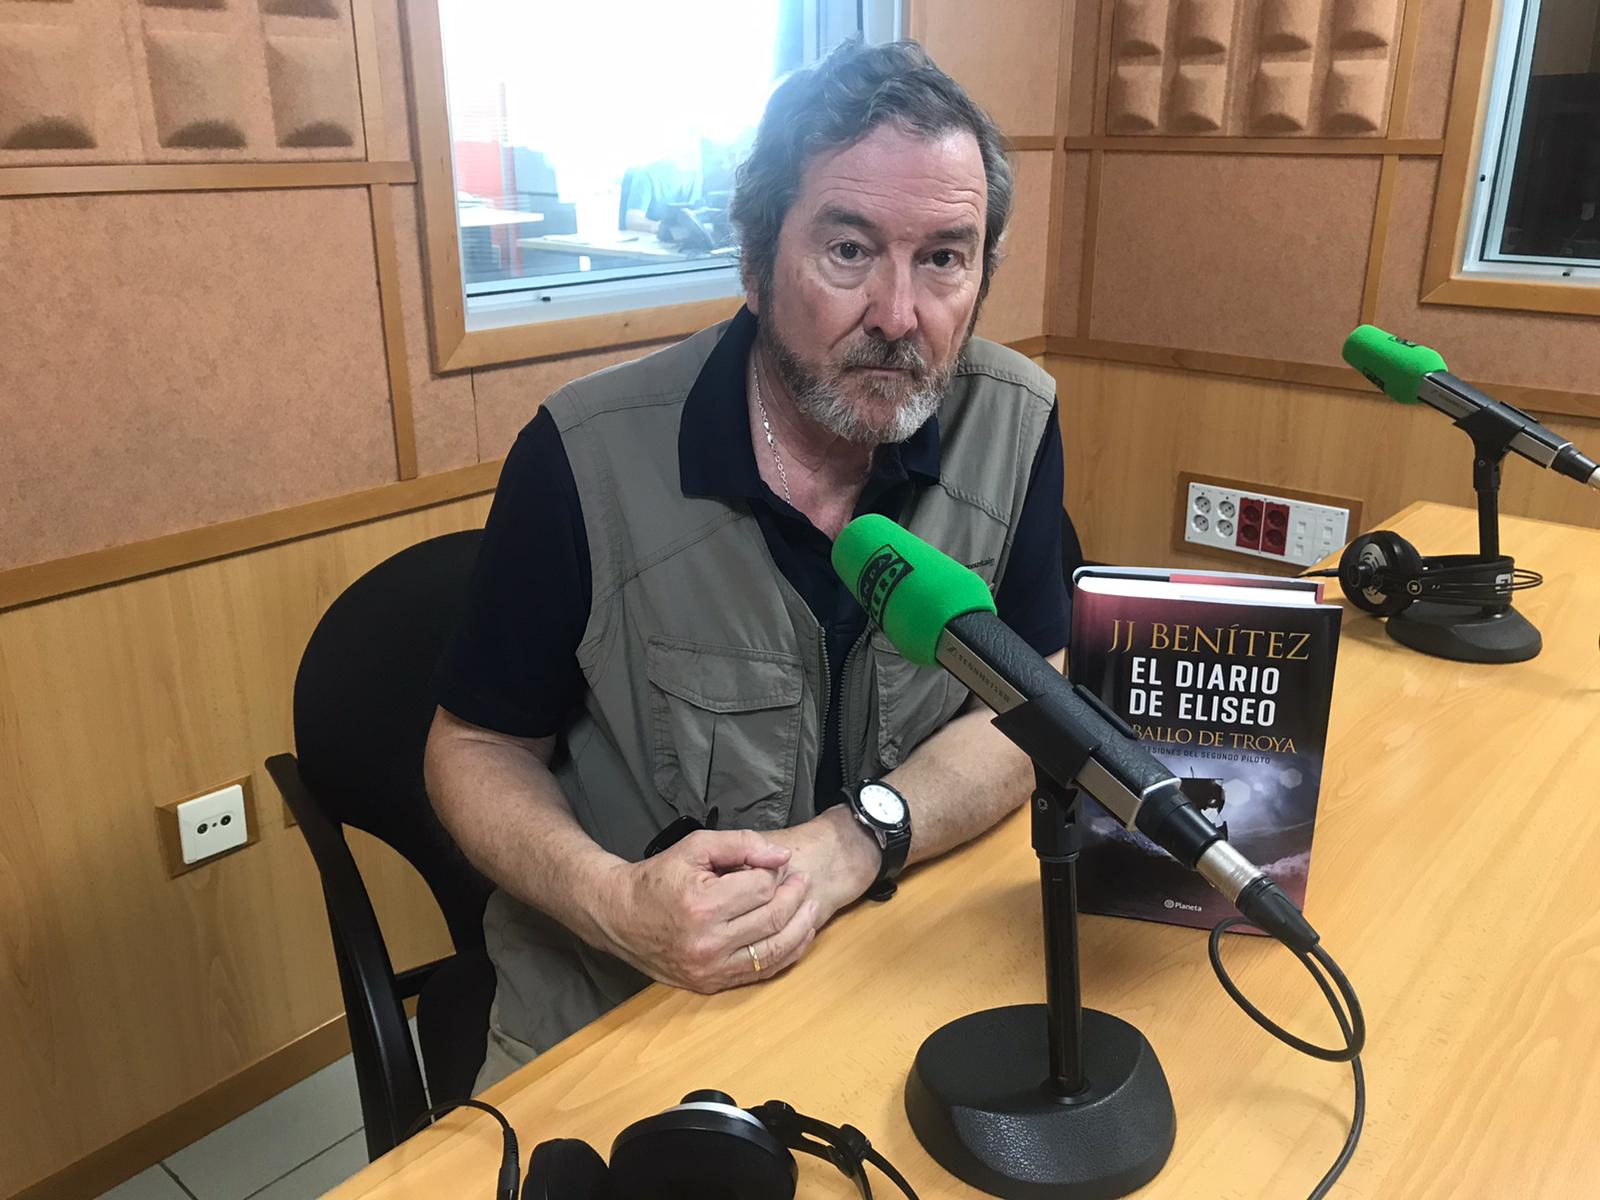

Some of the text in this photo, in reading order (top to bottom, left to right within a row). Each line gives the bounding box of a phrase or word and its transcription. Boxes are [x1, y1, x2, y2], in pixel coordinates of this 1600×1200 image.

[1108, 619, 1311, 660] JJ BENÍTEZ
[1131, 656, 1280, 695] EL DIARIO
[1129, 688, 1276, 727] DE ELISEO
[1132, 724, 1297, 754] BALLO DE TROYA
[1143, 745, 1270, 764] ESIONES DEL SEGUNDO PILOTO
[1174, 902, 1202, 912] Planeta
